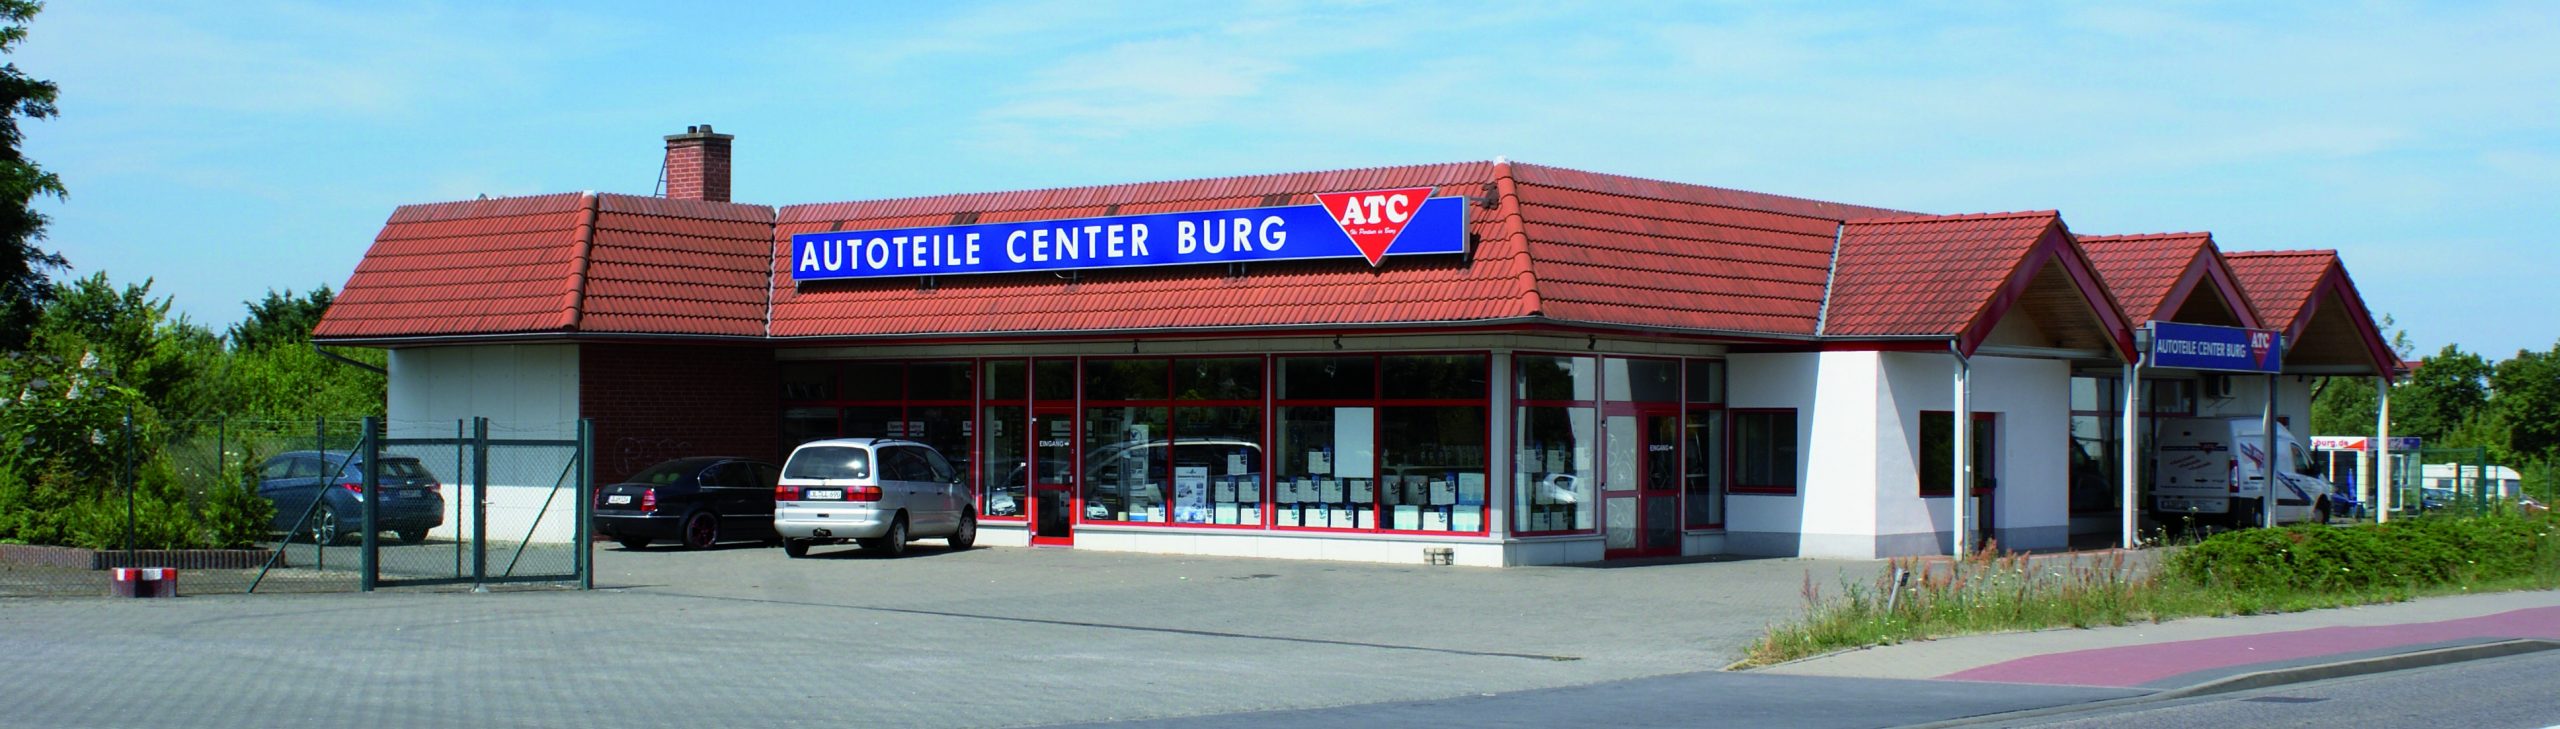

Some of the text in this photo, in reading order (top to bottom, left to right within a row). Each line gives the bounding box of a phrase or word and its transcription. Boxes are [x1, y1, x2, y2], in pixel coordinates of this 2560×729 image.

[1340, 194, 1408, 225] ATC
[799, 215, 1287, 272] AUTOTEILE CENTER BURG
[2157, 339, 2247, 358] AUTOTEILE CENTER BURG
[2250, 332, 2270, 348] ATC
